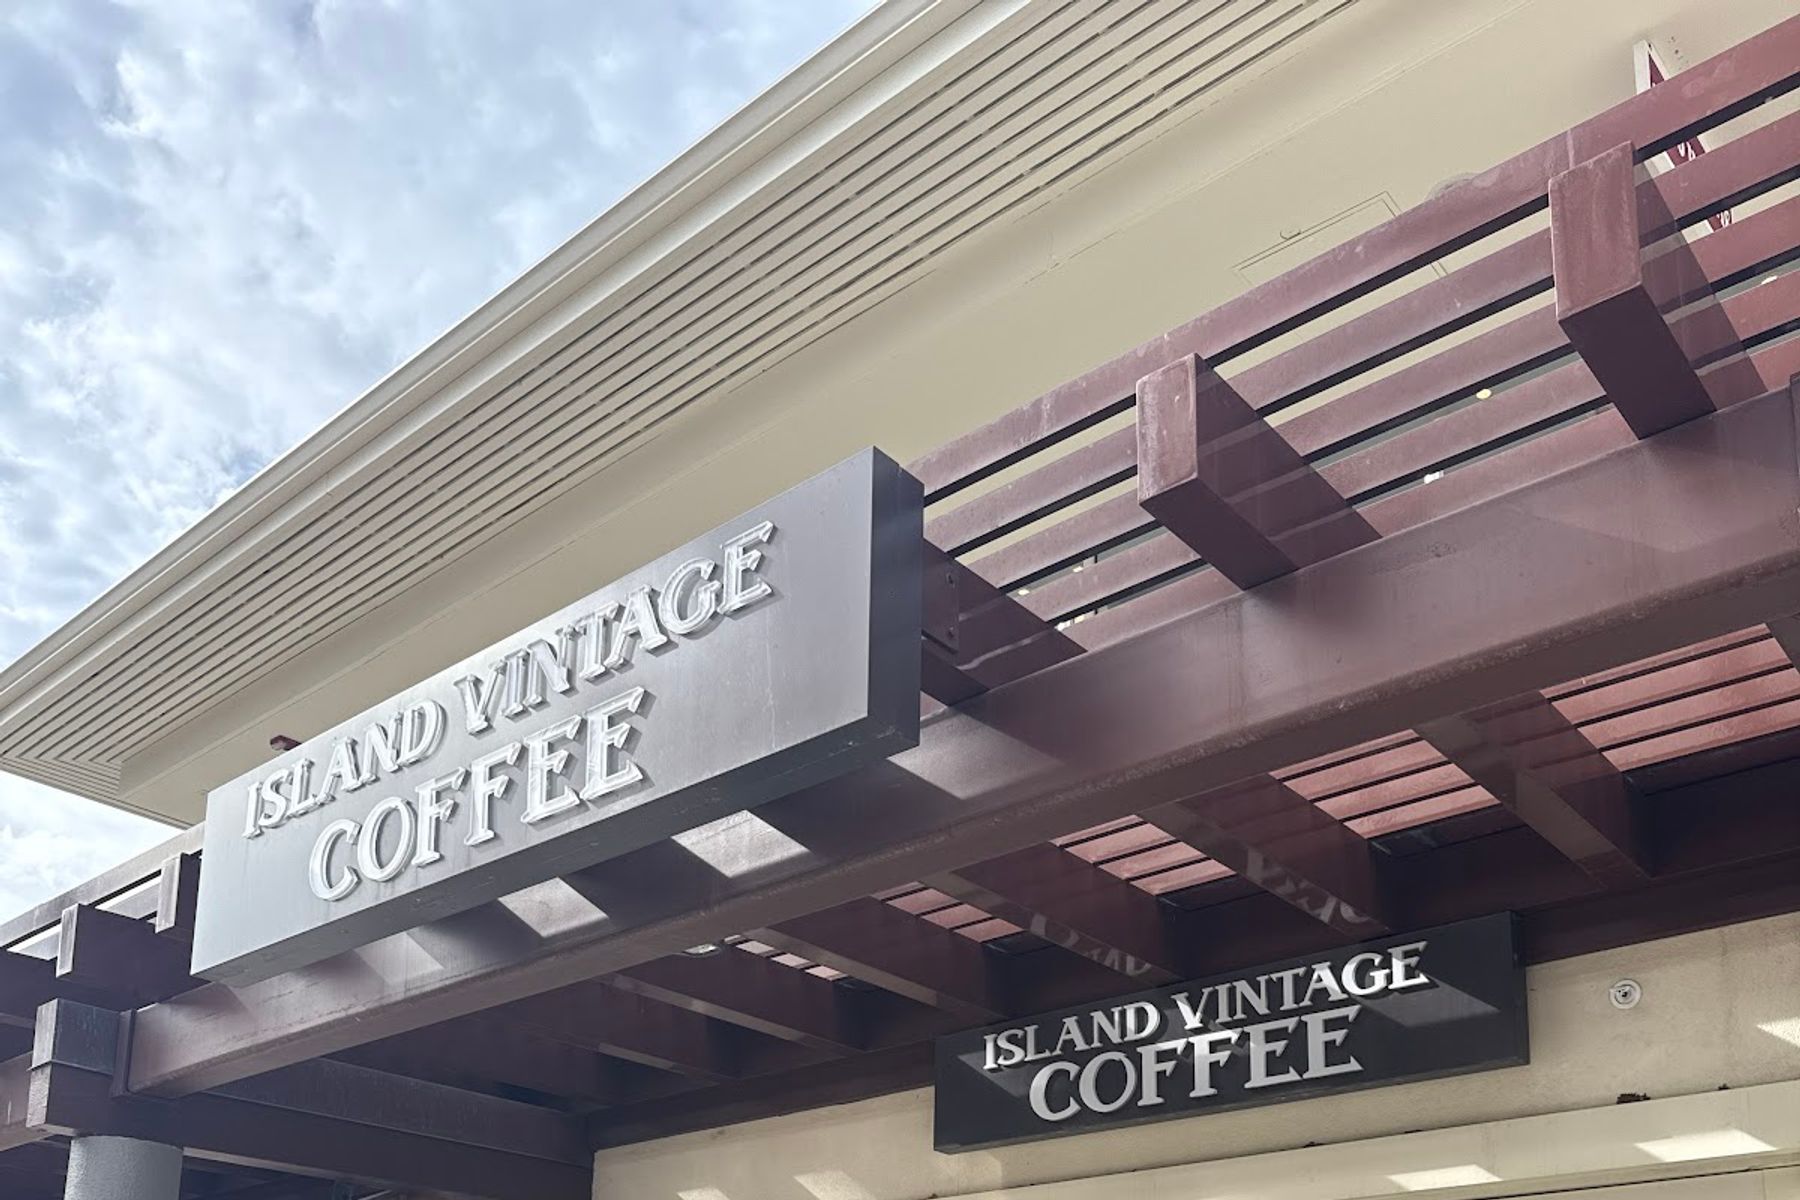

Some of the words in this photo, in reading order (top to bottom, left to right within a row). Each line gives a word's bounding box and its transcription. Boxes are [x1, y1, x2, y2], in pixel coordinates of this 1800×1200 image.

[242, 700, 446, 839] ISLAND
[454, 520, 775, 734] VINTAGE
[308, 687, 649, 900] COFFEE
[983, 1001, 1161, 1070] ISLAND
[1171, 941, 1428, 1030] VINTAGE
[1029, 1005, 1364, 1121] COFFEE
